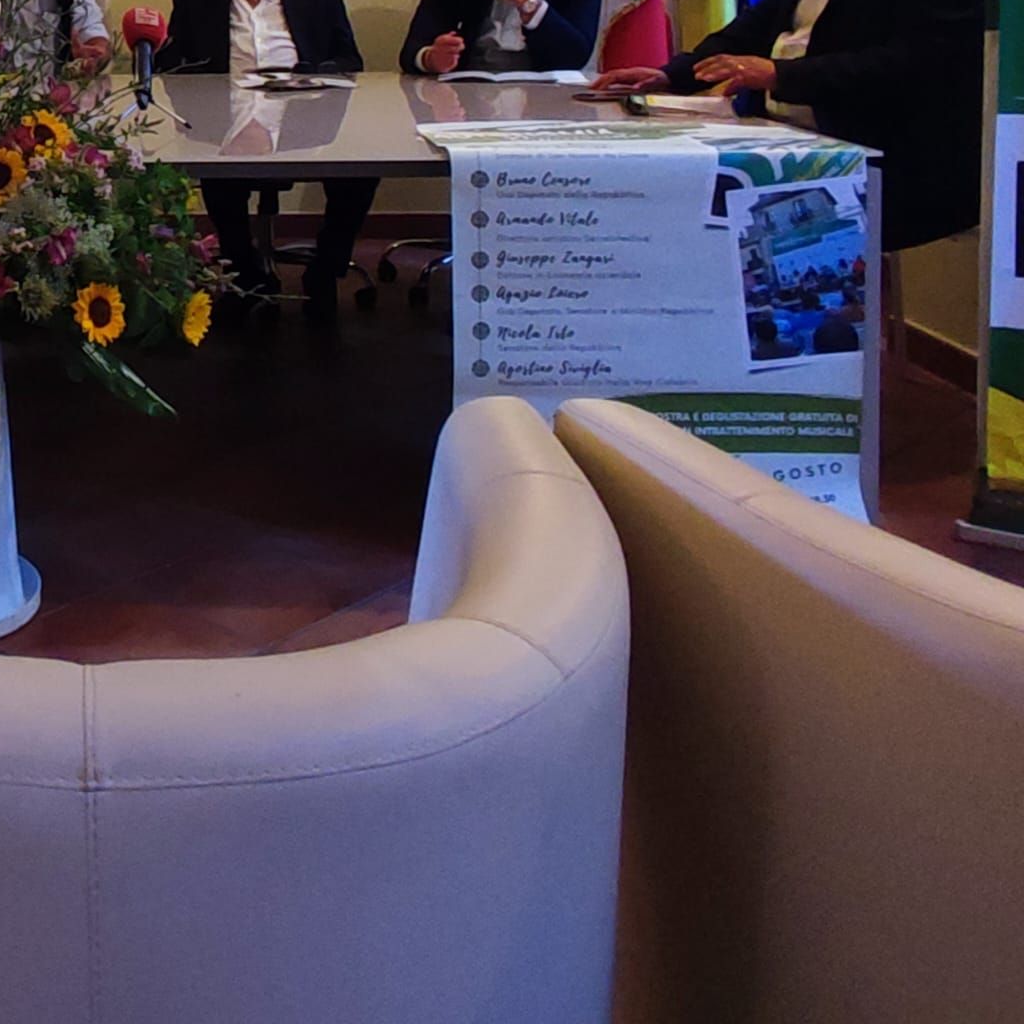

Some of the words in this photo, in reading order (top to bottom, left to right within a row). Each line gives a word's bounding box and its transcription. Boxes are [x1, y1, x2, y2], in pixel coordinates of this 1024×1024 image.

[496, 171, 536, 188] Bruno
[496, 211, 554, 226] Armando
[496, 250, 555, 269] Giuseppe
[497, 324, 542, 340] Nicola
[789, 412, 843, 423] GRATUITA
[846, 413, 860, 423] DI
[798, 426, 855, 437] MUSICALE
[772, 462, 843, 482] GOSTO
